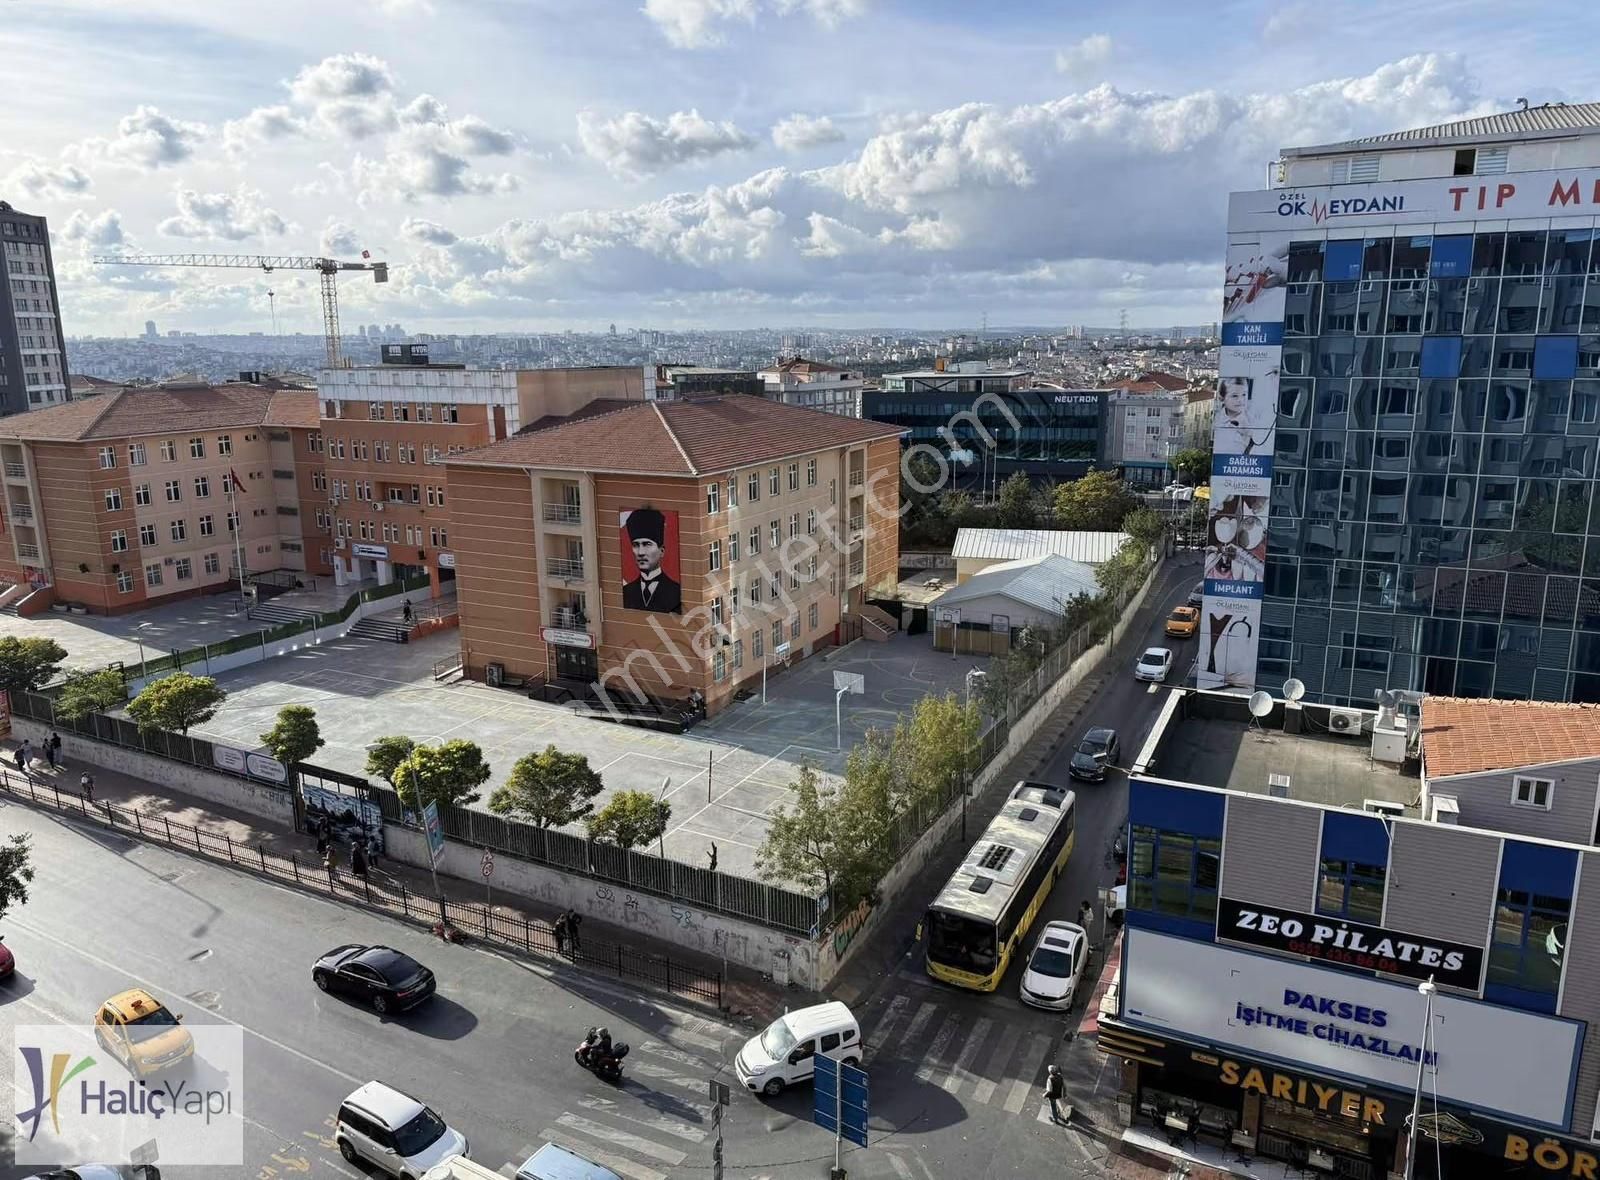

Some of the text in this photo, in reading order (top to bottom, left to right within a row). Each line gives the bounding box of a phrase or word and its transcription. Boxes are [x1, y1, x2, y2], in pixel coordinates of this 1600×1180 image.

[1277, 196, 1405, 225] OKMEYDANI
[1279, 193, 1307, 201] ÖZEL
[1448, 183, 1516, 211] TIP
[1243, 324, 1262, 334] KAN
[1054, 395, 1098, 404] NEUTRON
[1222, 465, 1264, 475] TARAMASI
[1228, 456, 1258, 466] SAĞLIK
[1214, 582, 1254, 594] İMPLANT
[1235, 910, 1465, 972] ZEO PİLATES
[1283, 989, 1388, 1028] PAKSES
[1235, 1001, 1308, 1035] İŞİTME
[1313, 1023, 1438, 1066] CİHAZLARI
[1219, 1060, 1386, 1126] SARIYER
[1504, 1134, 1598, 1180] BÖR
